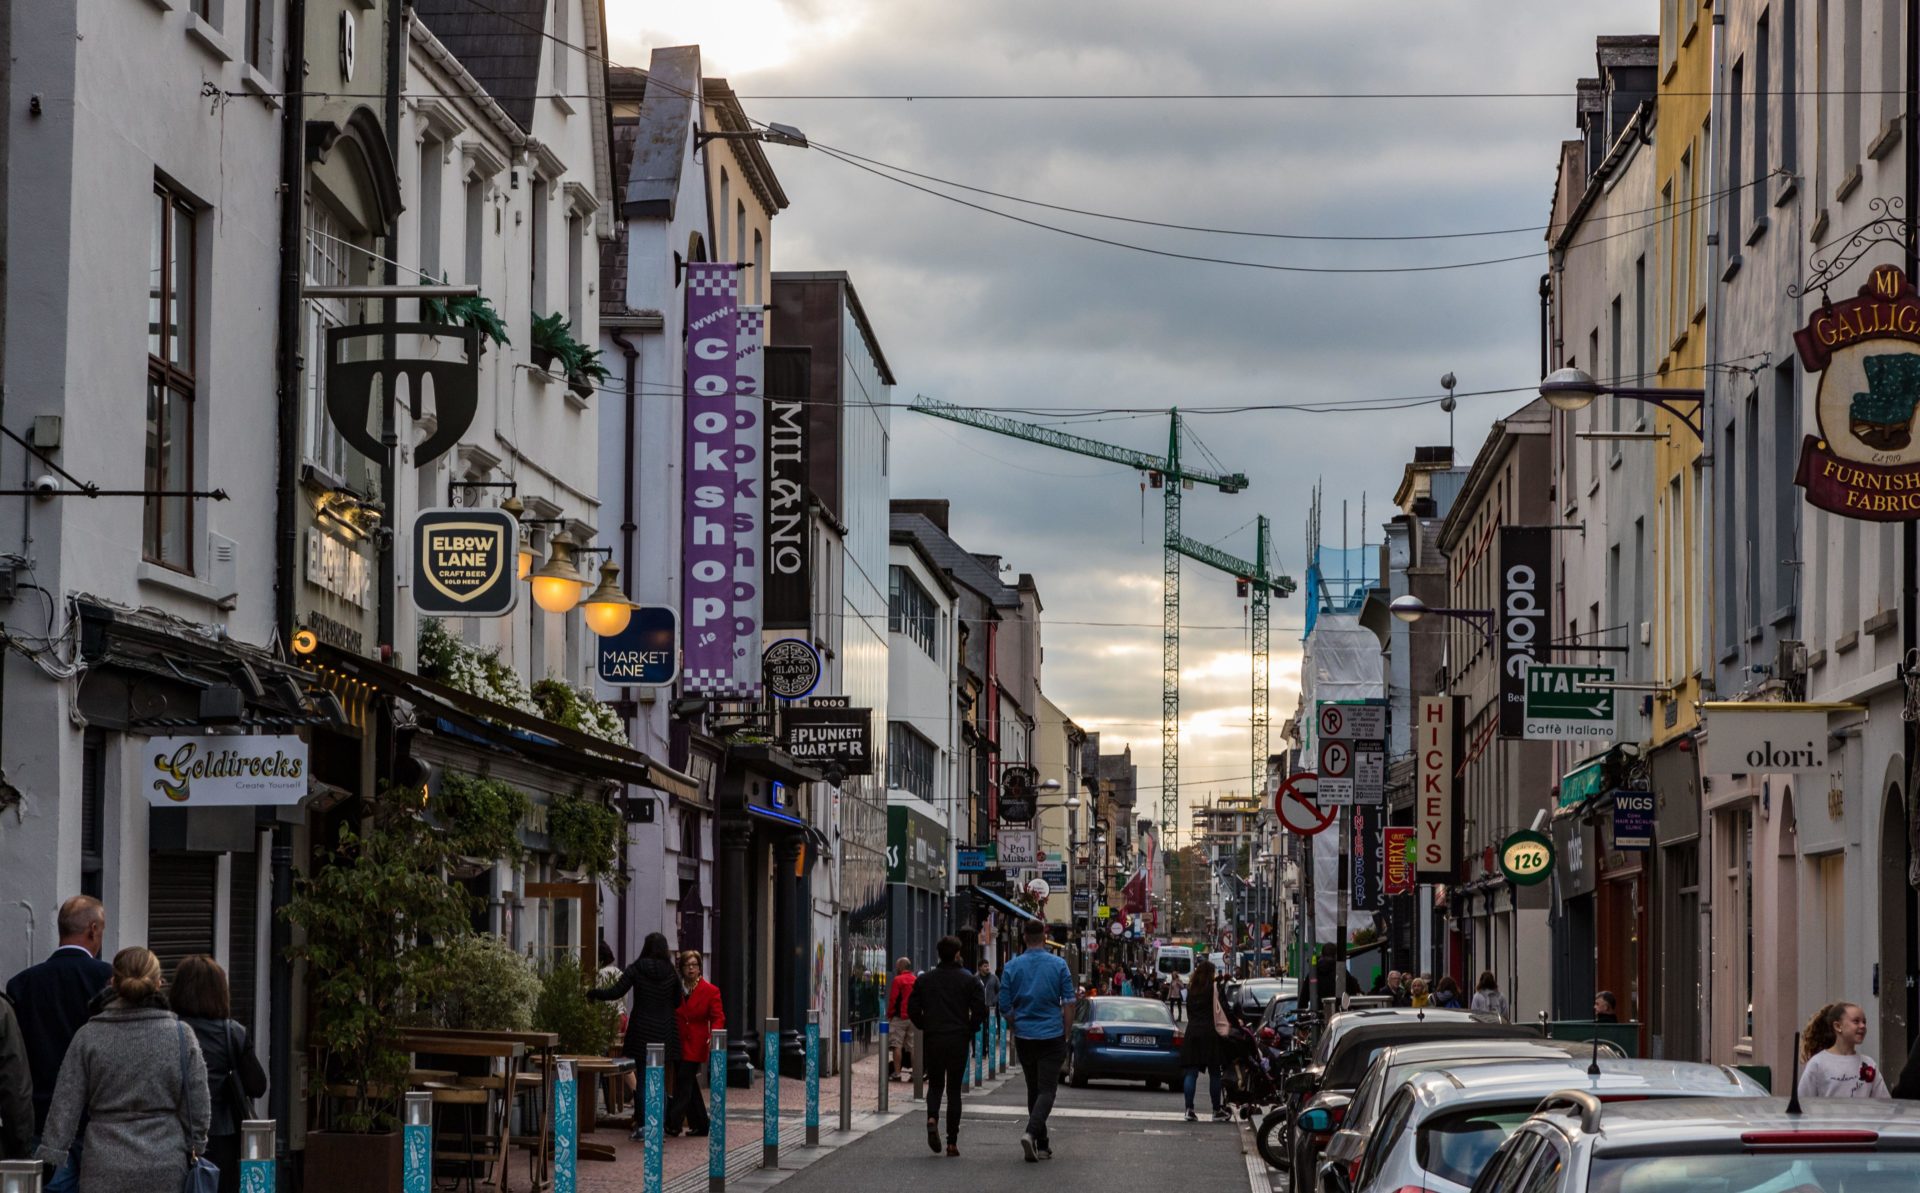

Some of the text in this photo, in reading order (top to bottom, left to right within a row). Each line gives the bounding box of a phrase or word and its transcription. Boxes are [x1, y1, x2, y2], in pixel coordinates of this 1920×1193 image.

[1876, 270, 1900, 298] MJ
[690, 306, 735, 331] www.
[1817, 304, 1920, 346] GALLIG
[692, 338, 729, 627] cookshop
[771, 401, 802, 574] MILANO
[433, 537, 494, 551] ELBOW
[438, 553, 487, 567] LANE
[439, 570, 487, 578] CRAFT BEER
[1507, 564, 1545, 680] adore
[698, 632, 717, 648] .ie
[603, 651, 669, 664] MARKET
[603, 664, 645, 677] LANE
[1508, 692, 1525, 702] Bea
[798, 728, 863, 742] PLUNKETT
[1527, 723, 1614, 736] Caffè Italiano
[1746, 740, 1823, 768] olori.
[153, 742, 303, 802] Goldirocks
[235, 781, 301, 789] Create Yourself
[1425, 703, 1443, 864] HICKEYS
[1616, 796, 1653, 811] WIGS
[1010, 844, 1026, 853] Pro
[1354, 804, 1365, 906] INTERSPORT
[1002, 854, 1033, 863] Musica
[1388, 840, 1406, 884] GALAXY
[1514, 852, 1543, 871] 126
